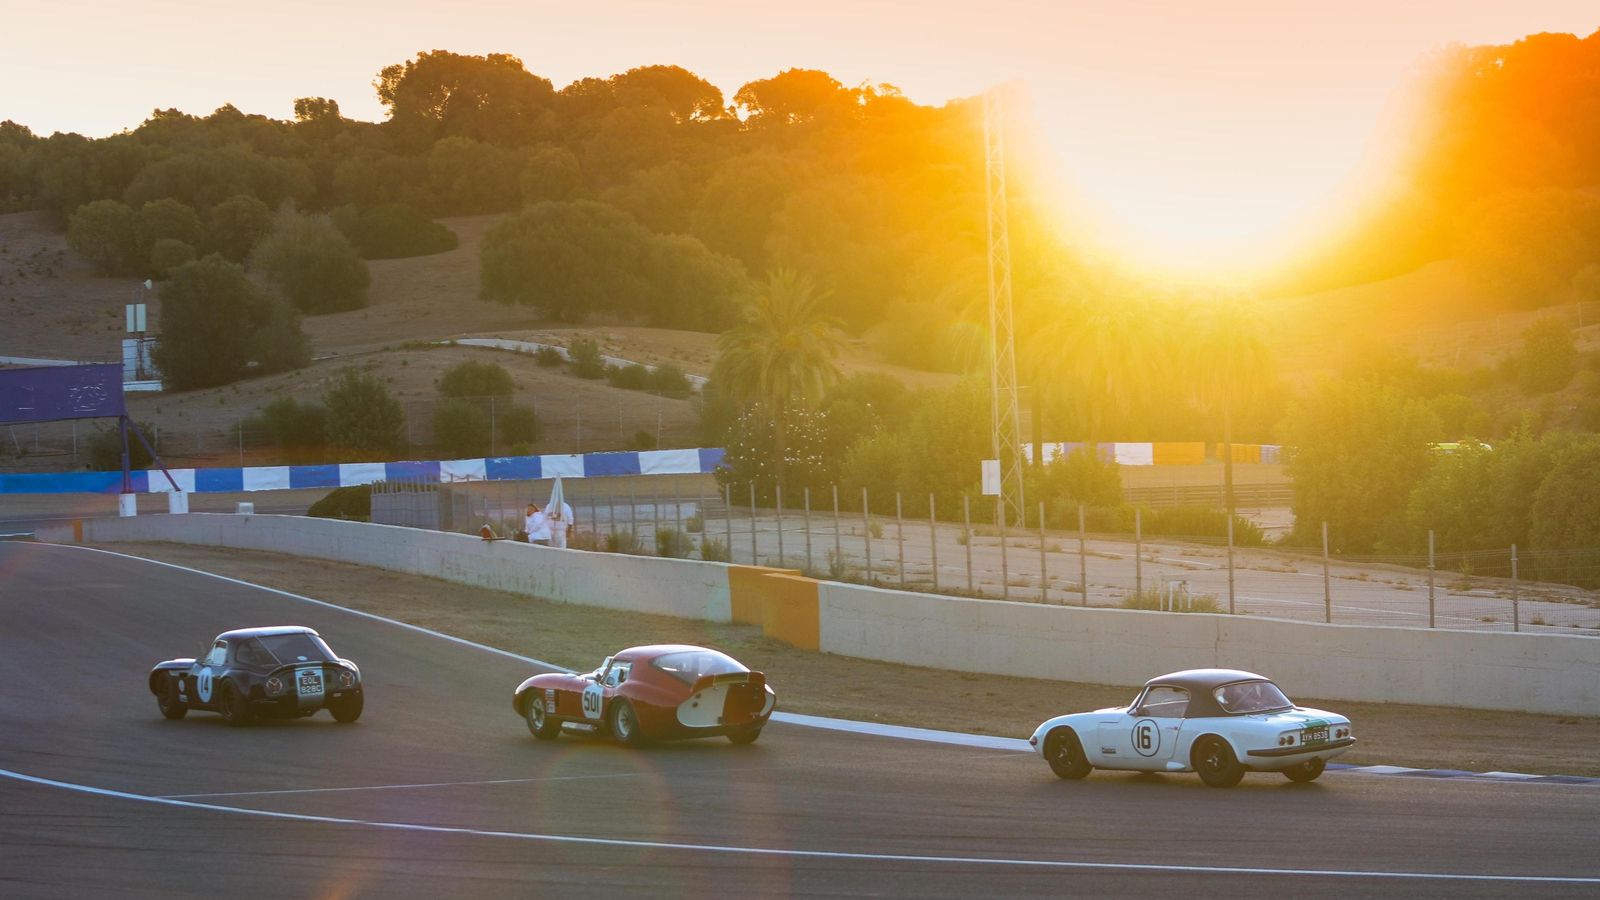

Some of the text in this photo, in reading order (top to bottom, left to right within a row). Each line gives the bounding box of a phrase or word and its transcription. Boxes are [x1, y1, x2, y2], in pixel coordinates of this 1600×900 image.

[200, 674, 209, 693] 14
[584, 690, 600, 712] 501
[1137, 726, 1151, 749] 16
